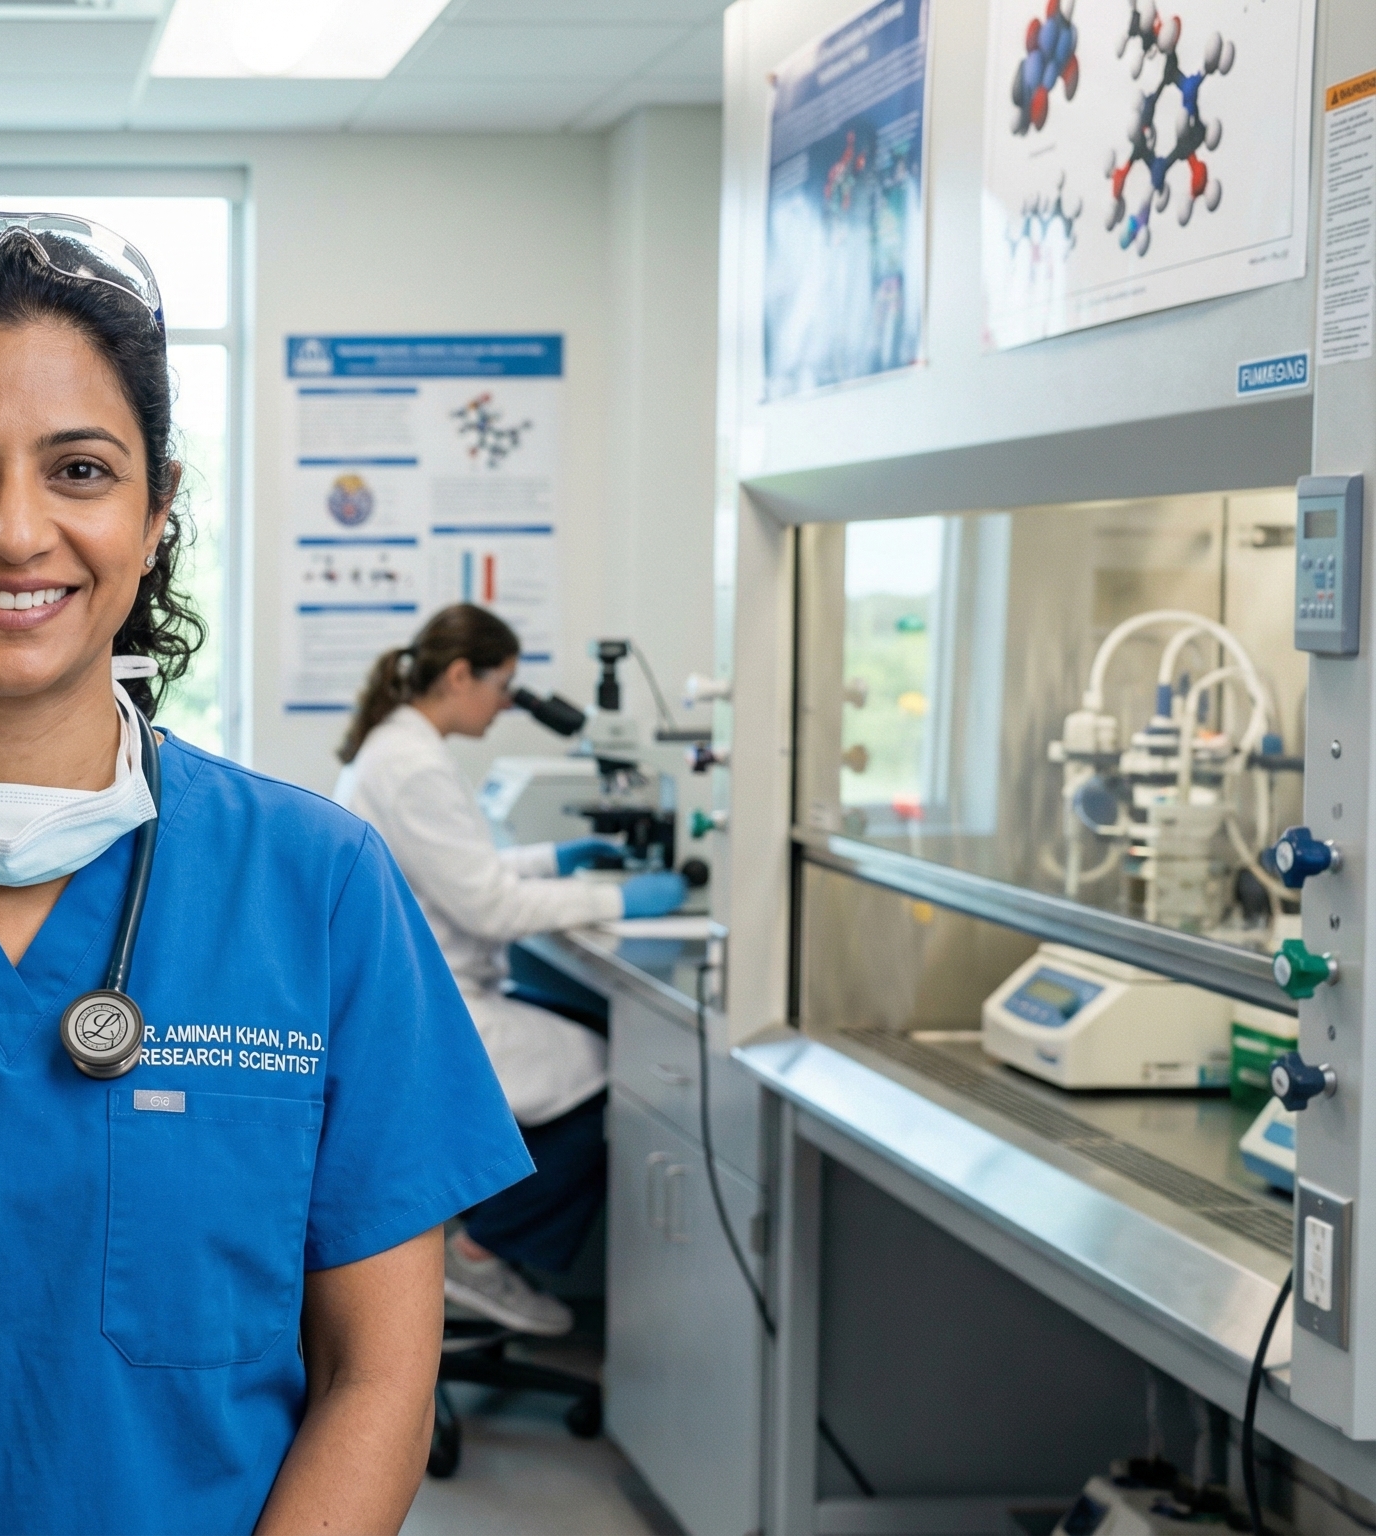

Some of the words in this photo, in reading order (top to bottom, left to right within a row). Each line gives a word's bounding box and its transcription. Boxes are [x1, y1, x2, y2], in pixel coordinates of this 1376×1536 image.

[143, 1025, 161, 1042] R.
[164, 1025, 231, 1043] AMINAH
[236, 1026, 283, 1051] KHAN,
[288, 1031, 324, 1051] Ph.D.
[139, 1048, 232, 1067] RESEARCH
[239, 1050, 319, 1075] SCIENTIST
